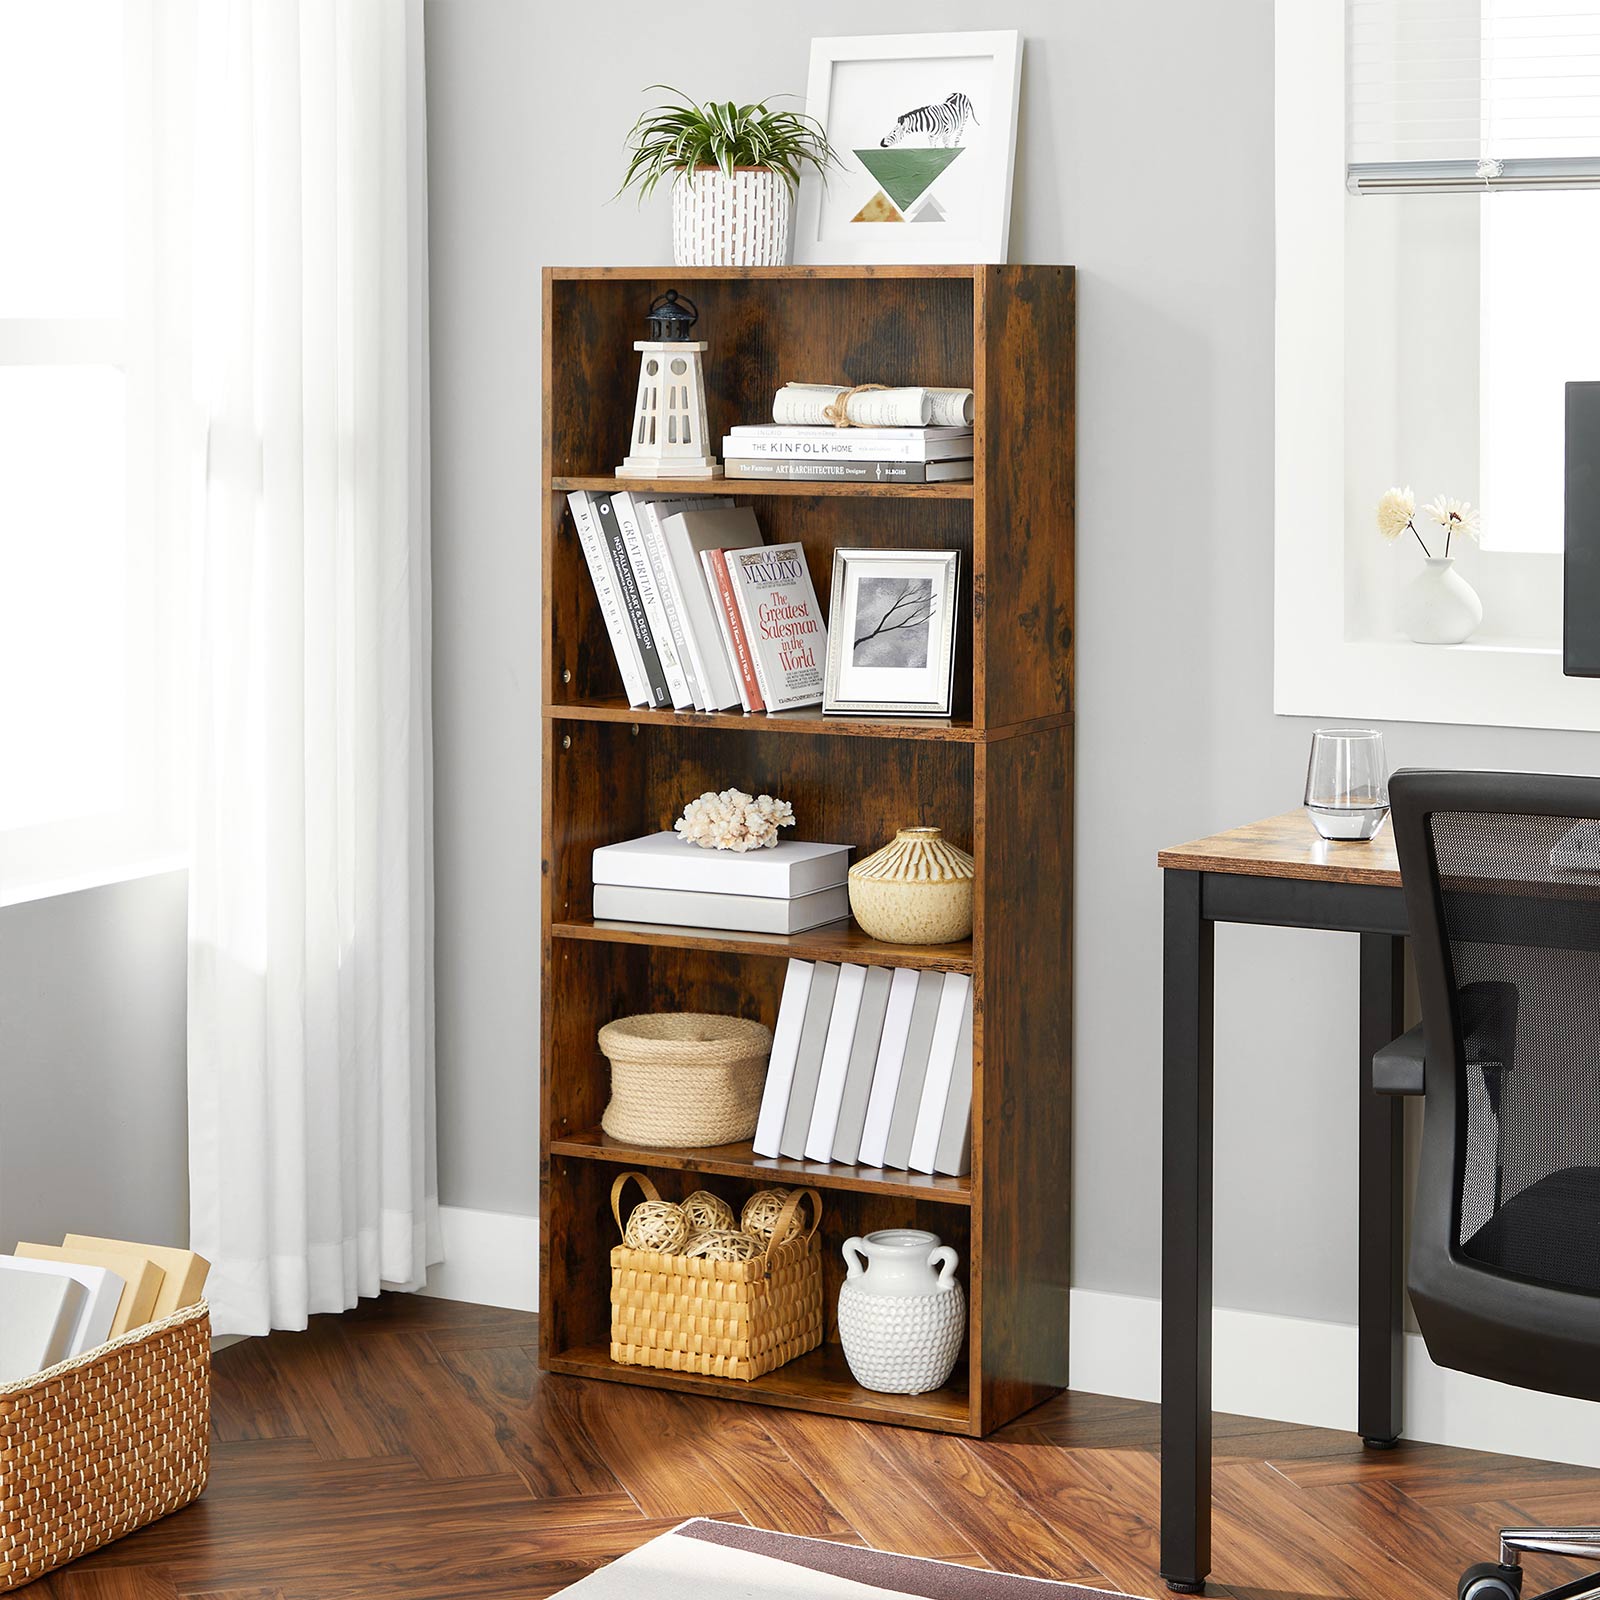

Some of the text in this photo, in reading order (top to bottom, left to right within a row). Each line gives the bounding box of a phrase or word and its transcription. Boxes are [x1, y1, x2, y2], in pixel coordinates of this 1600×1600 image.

[752, 443, 767, 452] THE
[770, 443, 830, 454] KINFOLK
[831, 445, 853, 453] HOME
[739, 464, 751, 472] The
[751, 464, 773, 473] Famous
[775, 464, 789, 474] ART
[795, 465, 845, 475] ARCHITECTURE
[623, 520, 642, 557] GREAT
[635, 559, 656, 605] BRITAIN
[762, 552, 777, 564] OG
[743, 560, 803, 584] MANDINO
[613, 536, 635, 593] INSTALLATION
[630, 594, 640, 609] ART
[637, 618, 652, 649] DESIGN
[645, 533, 663, 571] PUBLIC
[656, 571, 673, 606] SPACE
[666, 606, 685, 647] DESIGN
[770, 592, 788, 606] The
[758, 600, 809, 622] Greatest
[759, 618, 818, 640] Salesman
[781, 635, 804, 651] in the
[778, 648, 816, 671] World
